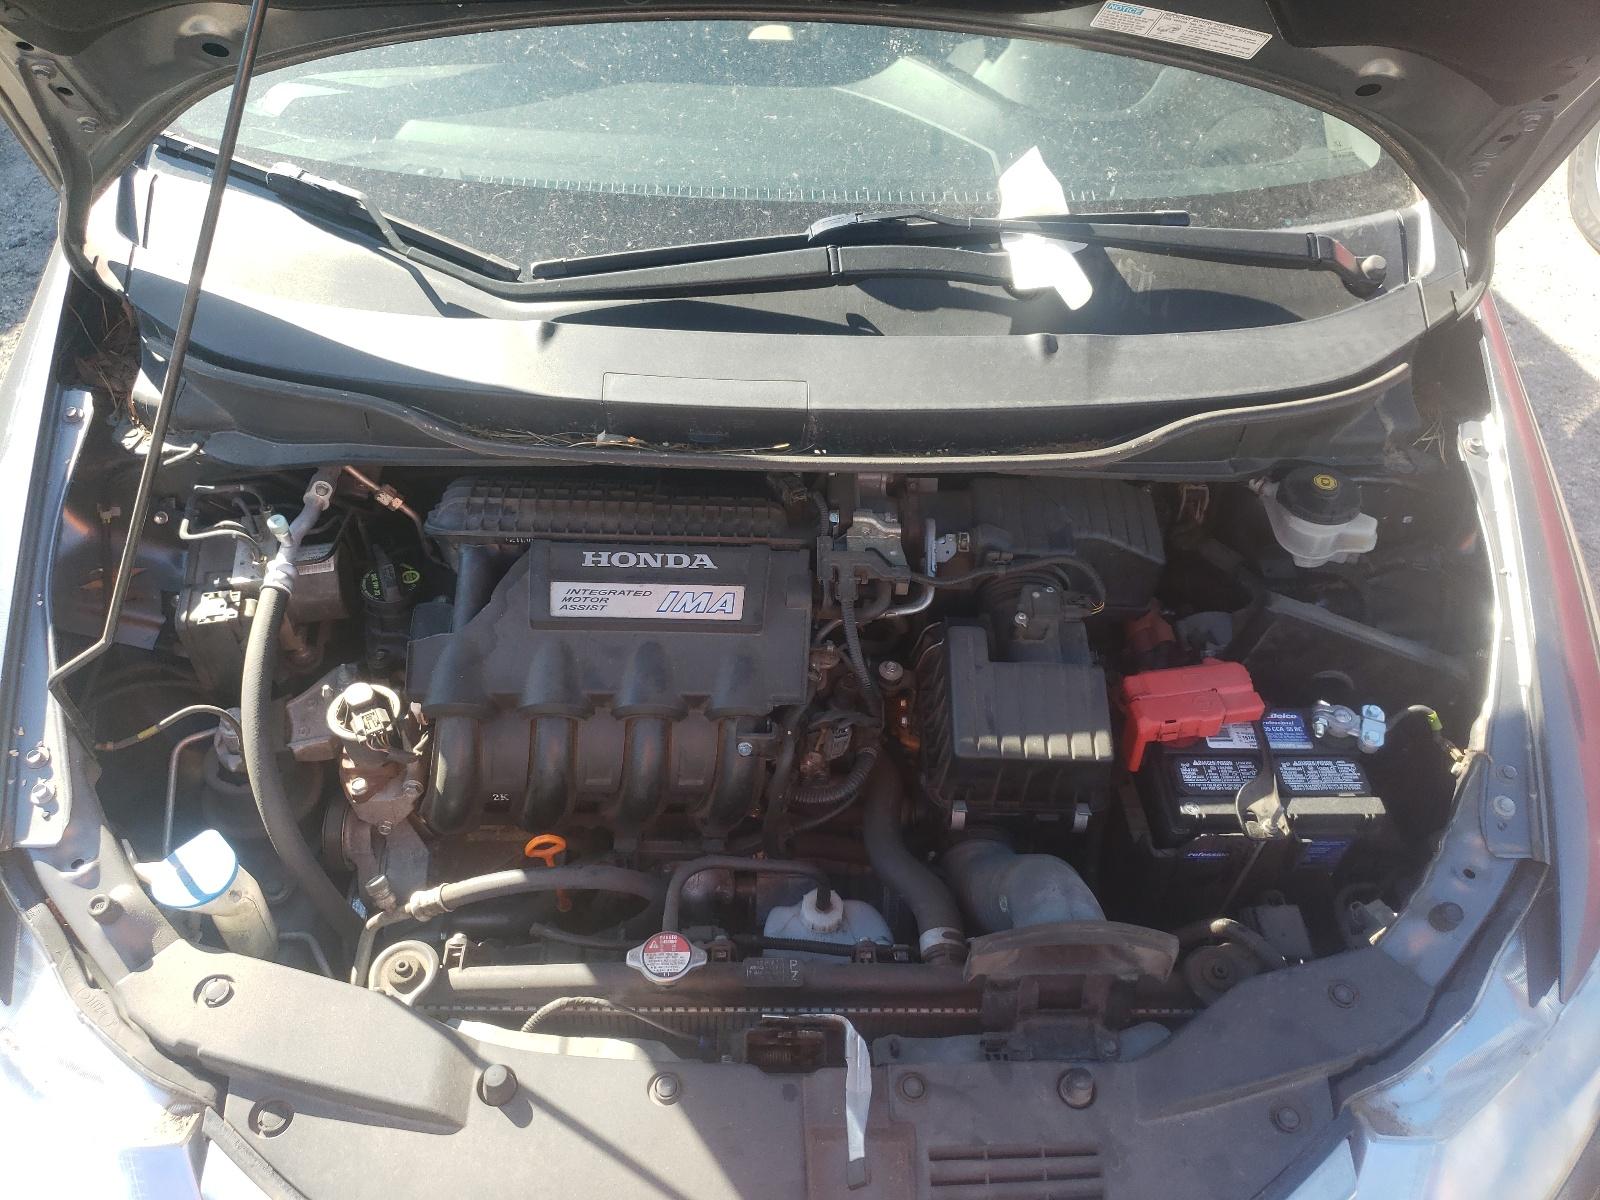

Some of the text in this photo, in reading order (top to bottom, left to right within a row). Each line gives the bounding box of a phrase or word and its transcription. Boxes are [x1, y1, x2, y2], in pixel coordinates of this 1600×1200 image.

[581, 551, 719, 569] HONDA
[565, 588, 653, 597] INTEGRATED
[561, 596, 610, 604] MOTOR
[656, 591, 736, 614] IMA
[492, 793, 510, 801] 2K
